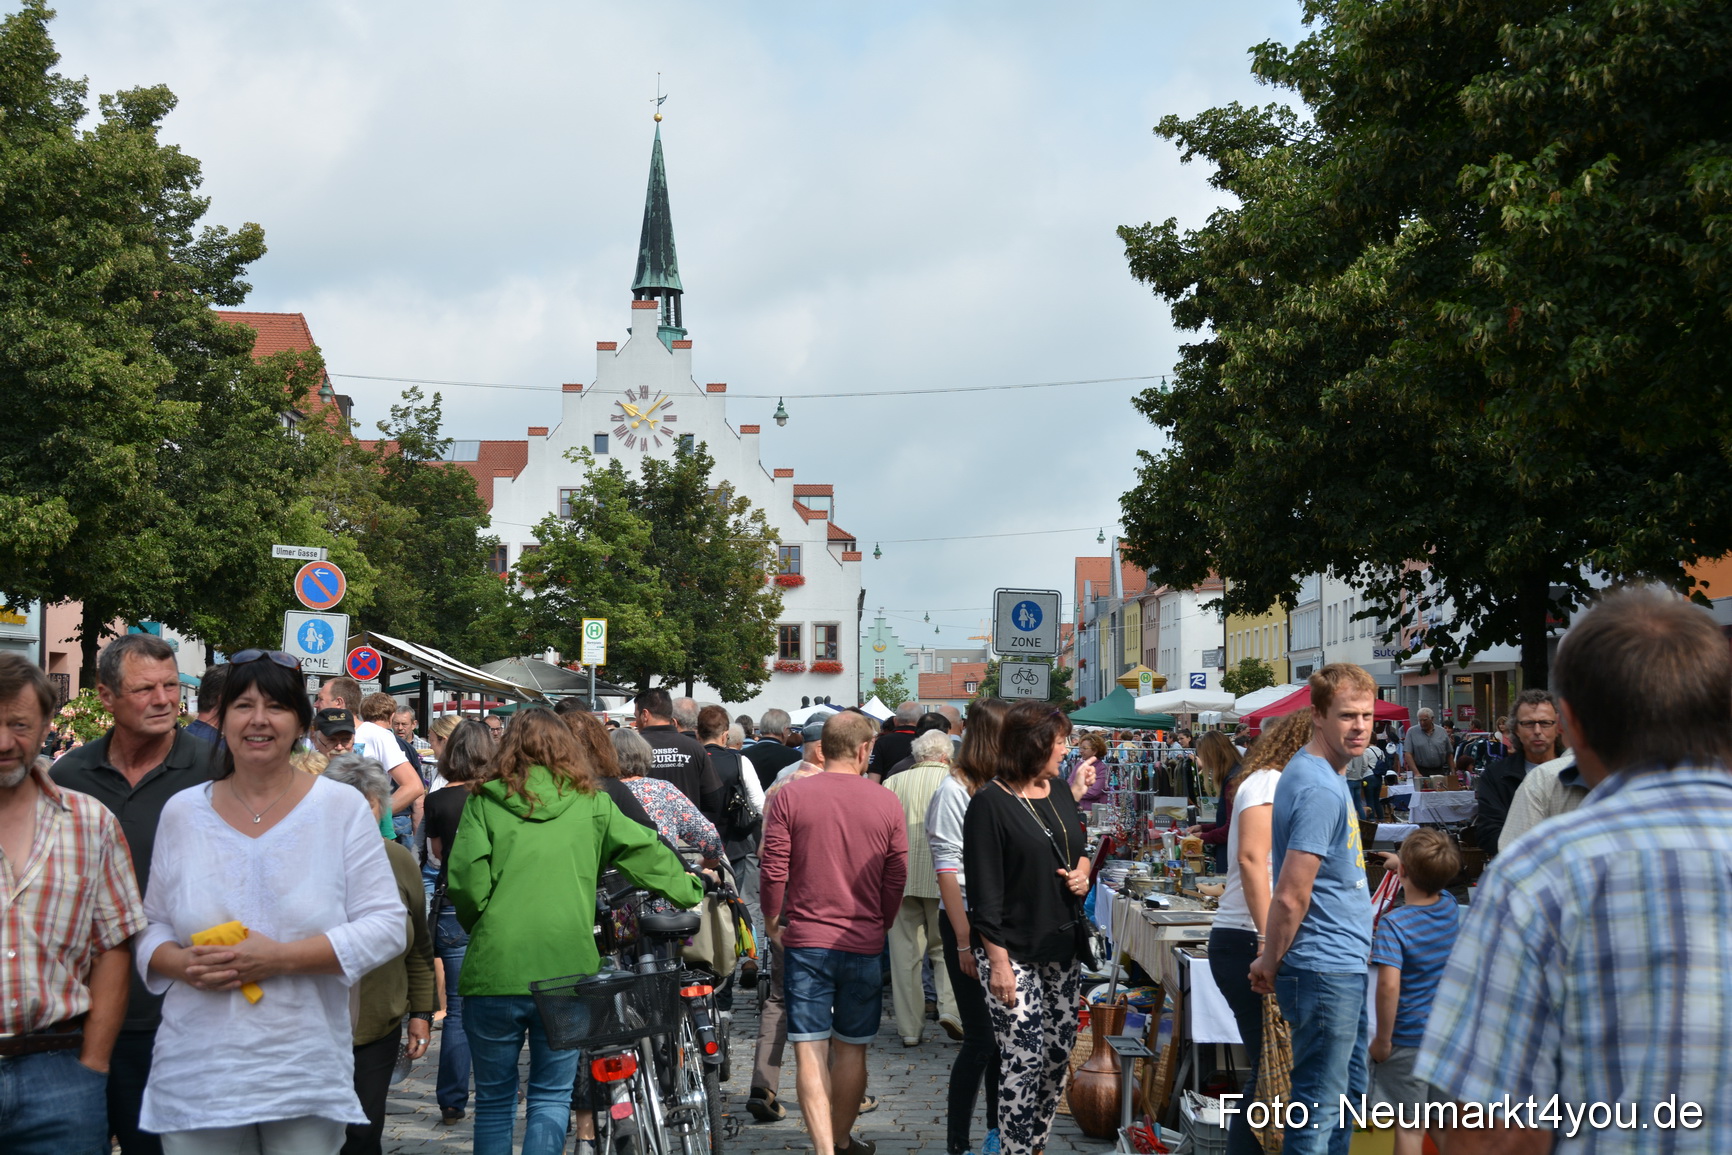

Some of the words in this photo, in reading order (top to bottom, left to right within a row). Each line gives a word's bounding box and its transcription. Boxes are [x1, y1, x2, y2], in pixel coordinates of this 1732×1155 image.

[276, 547, 296, 556] Ulmer
[298, 548, 318, 558] Gasse
[1011, 637, 1041, 647] ZONE
[652, 754, 691, 763] CURITY
